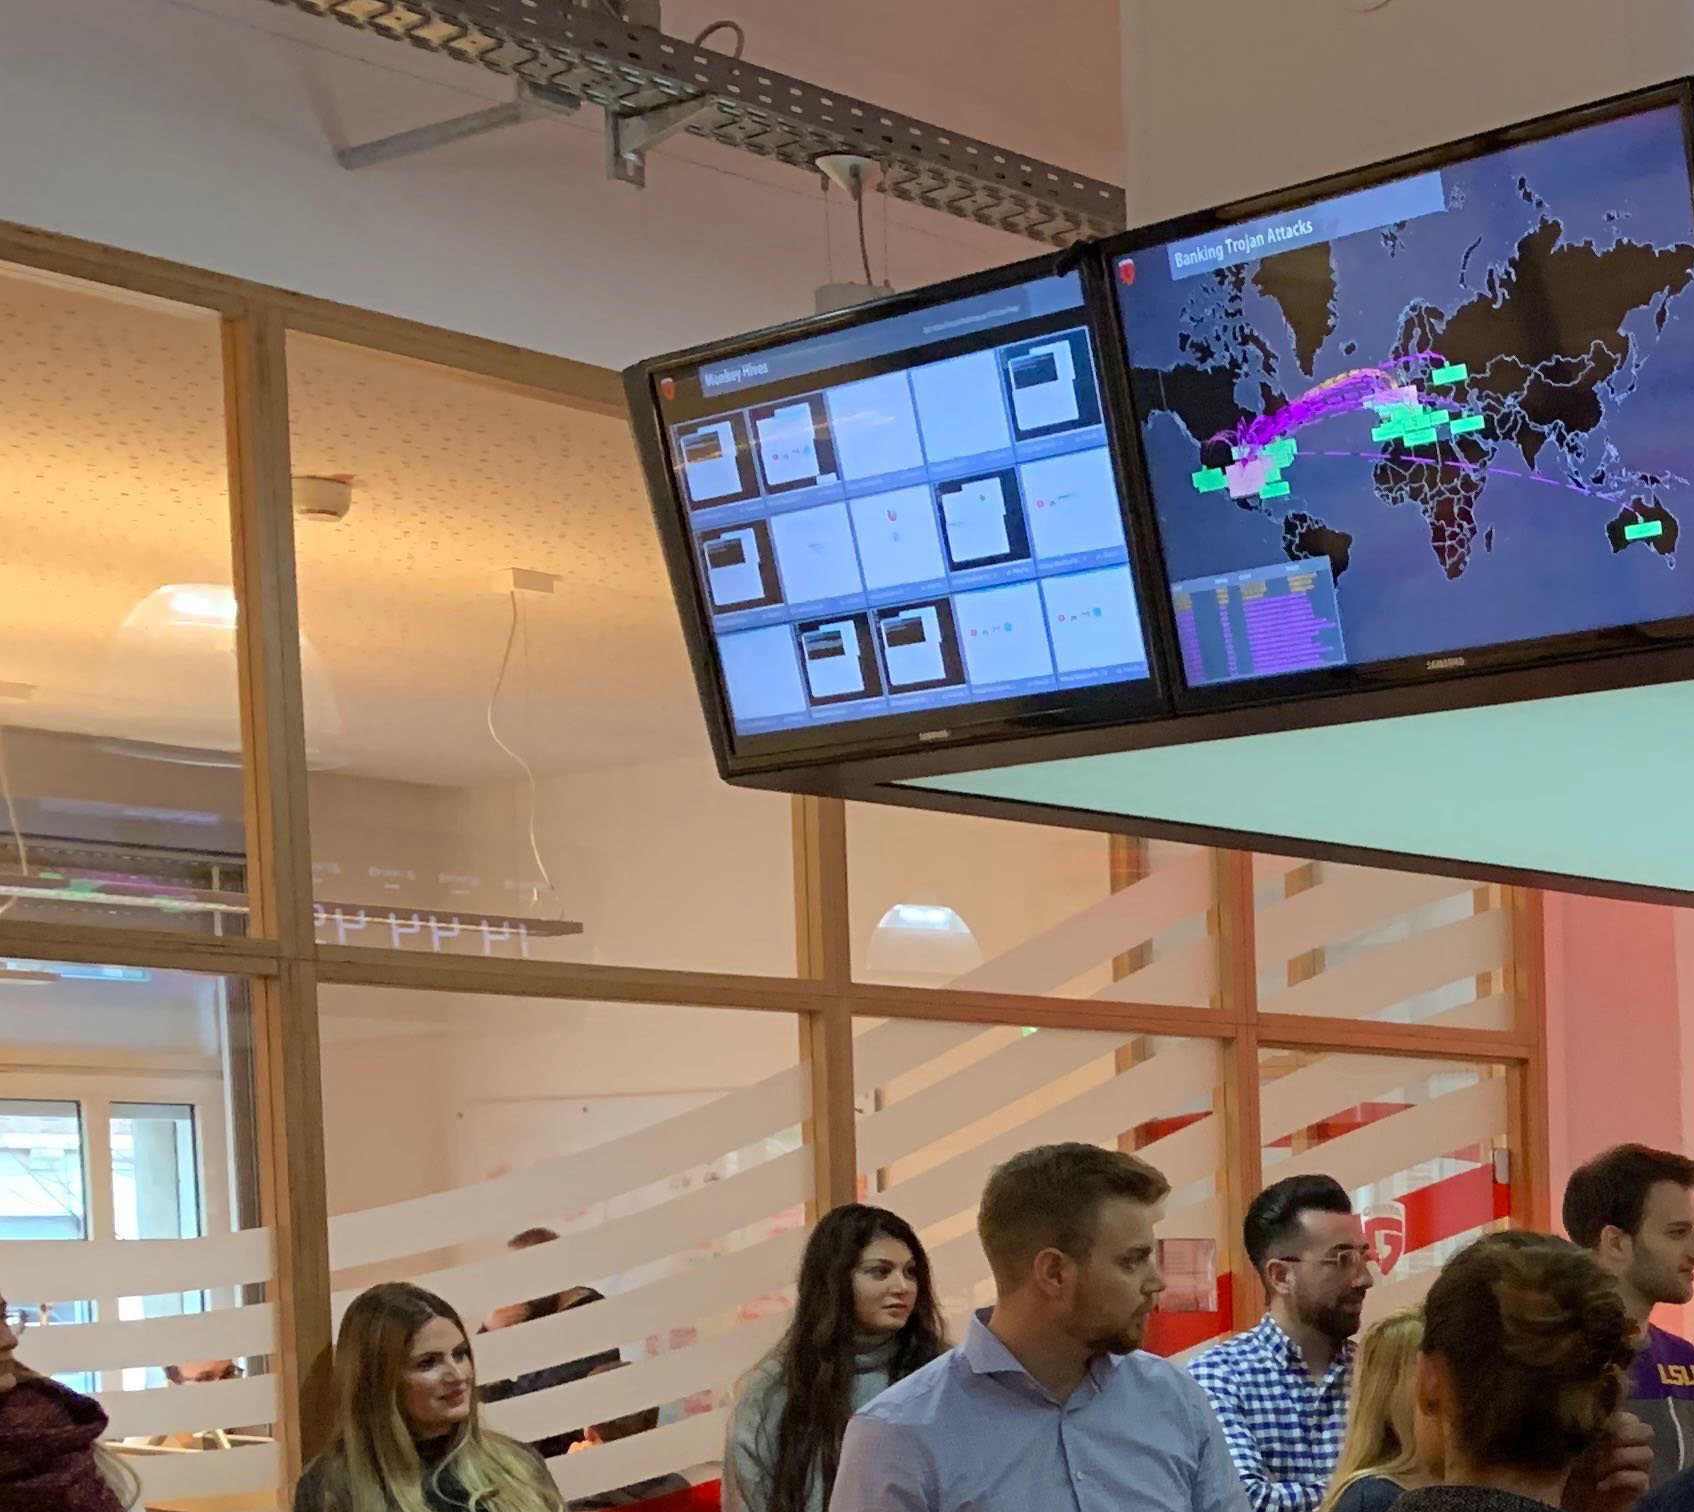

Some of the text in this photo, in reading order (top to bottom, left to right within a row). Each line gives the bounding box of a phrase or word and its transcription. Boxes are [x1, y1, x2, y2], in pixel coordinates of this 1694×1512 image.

[1174, 219, 1313, 268] Banking Trojan Attacks
